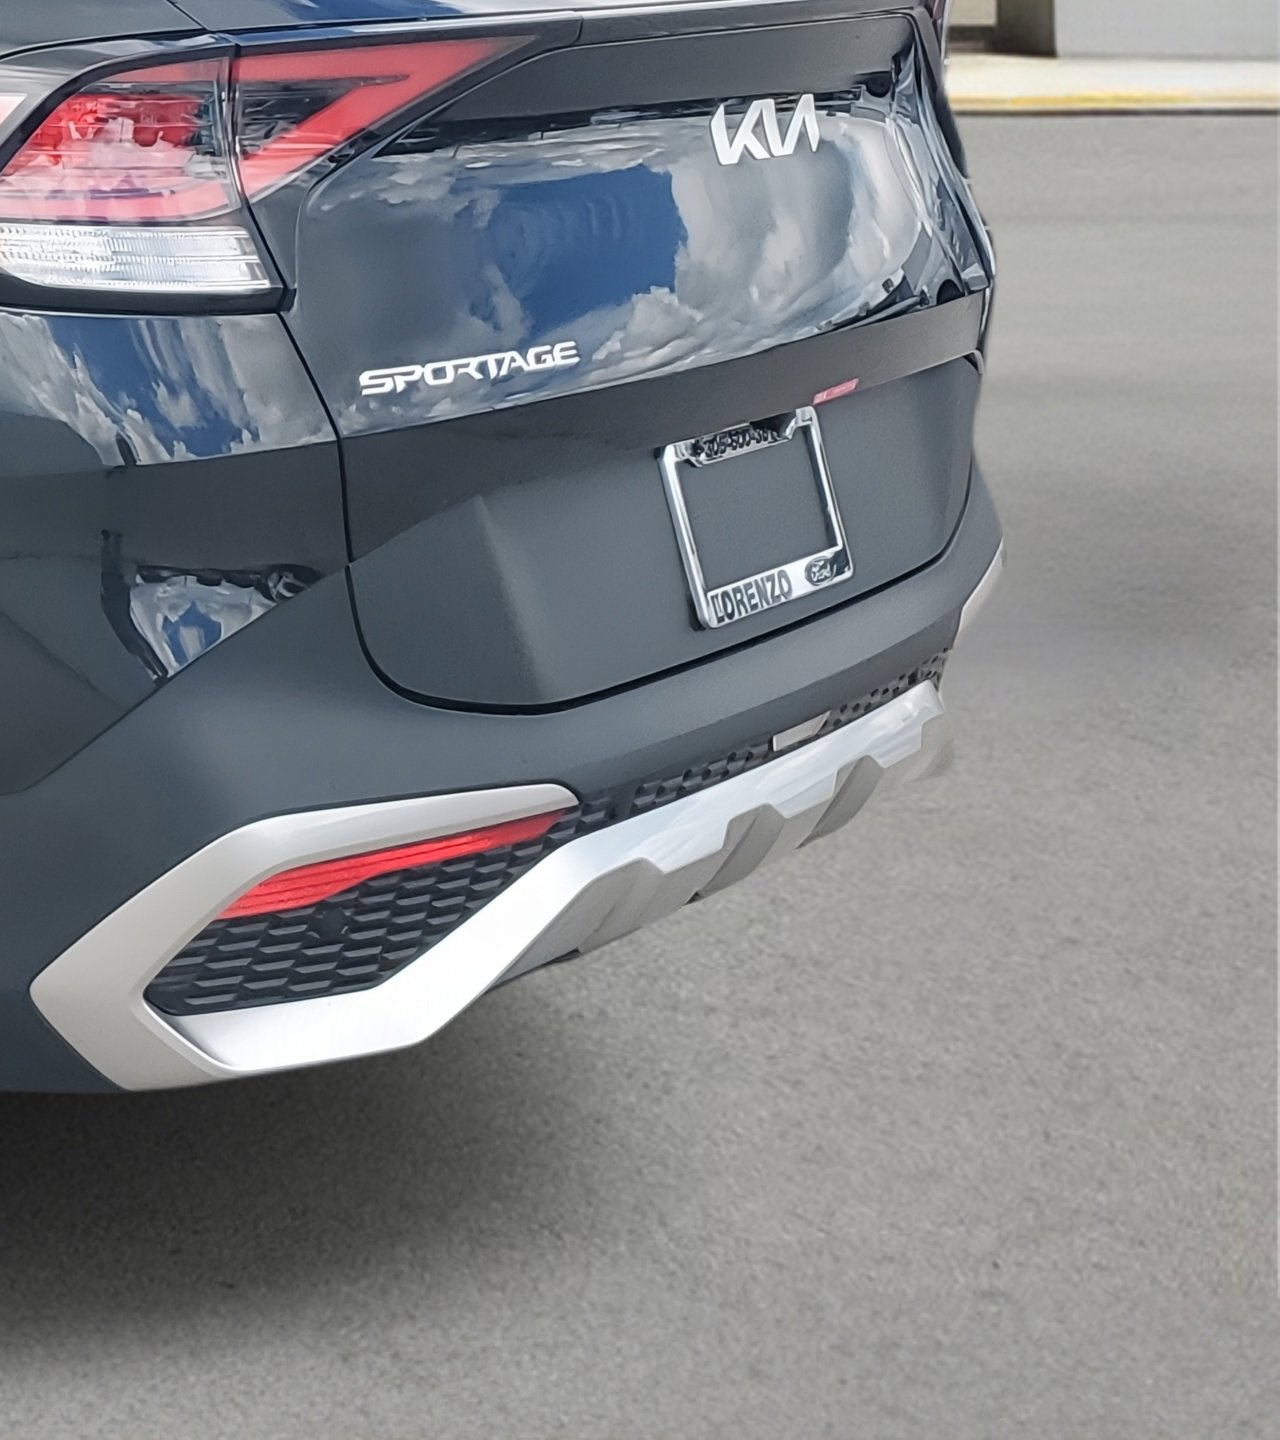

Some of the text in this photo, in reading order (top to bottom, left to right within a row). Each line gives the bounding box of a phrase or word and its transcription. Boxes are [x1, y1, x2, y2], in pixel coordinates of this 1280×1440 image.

[709, 92, 820, 165] KIA
[358, 340, 580, 396] SPORTAGE
[711, 569, 793, 624] LORENZO
